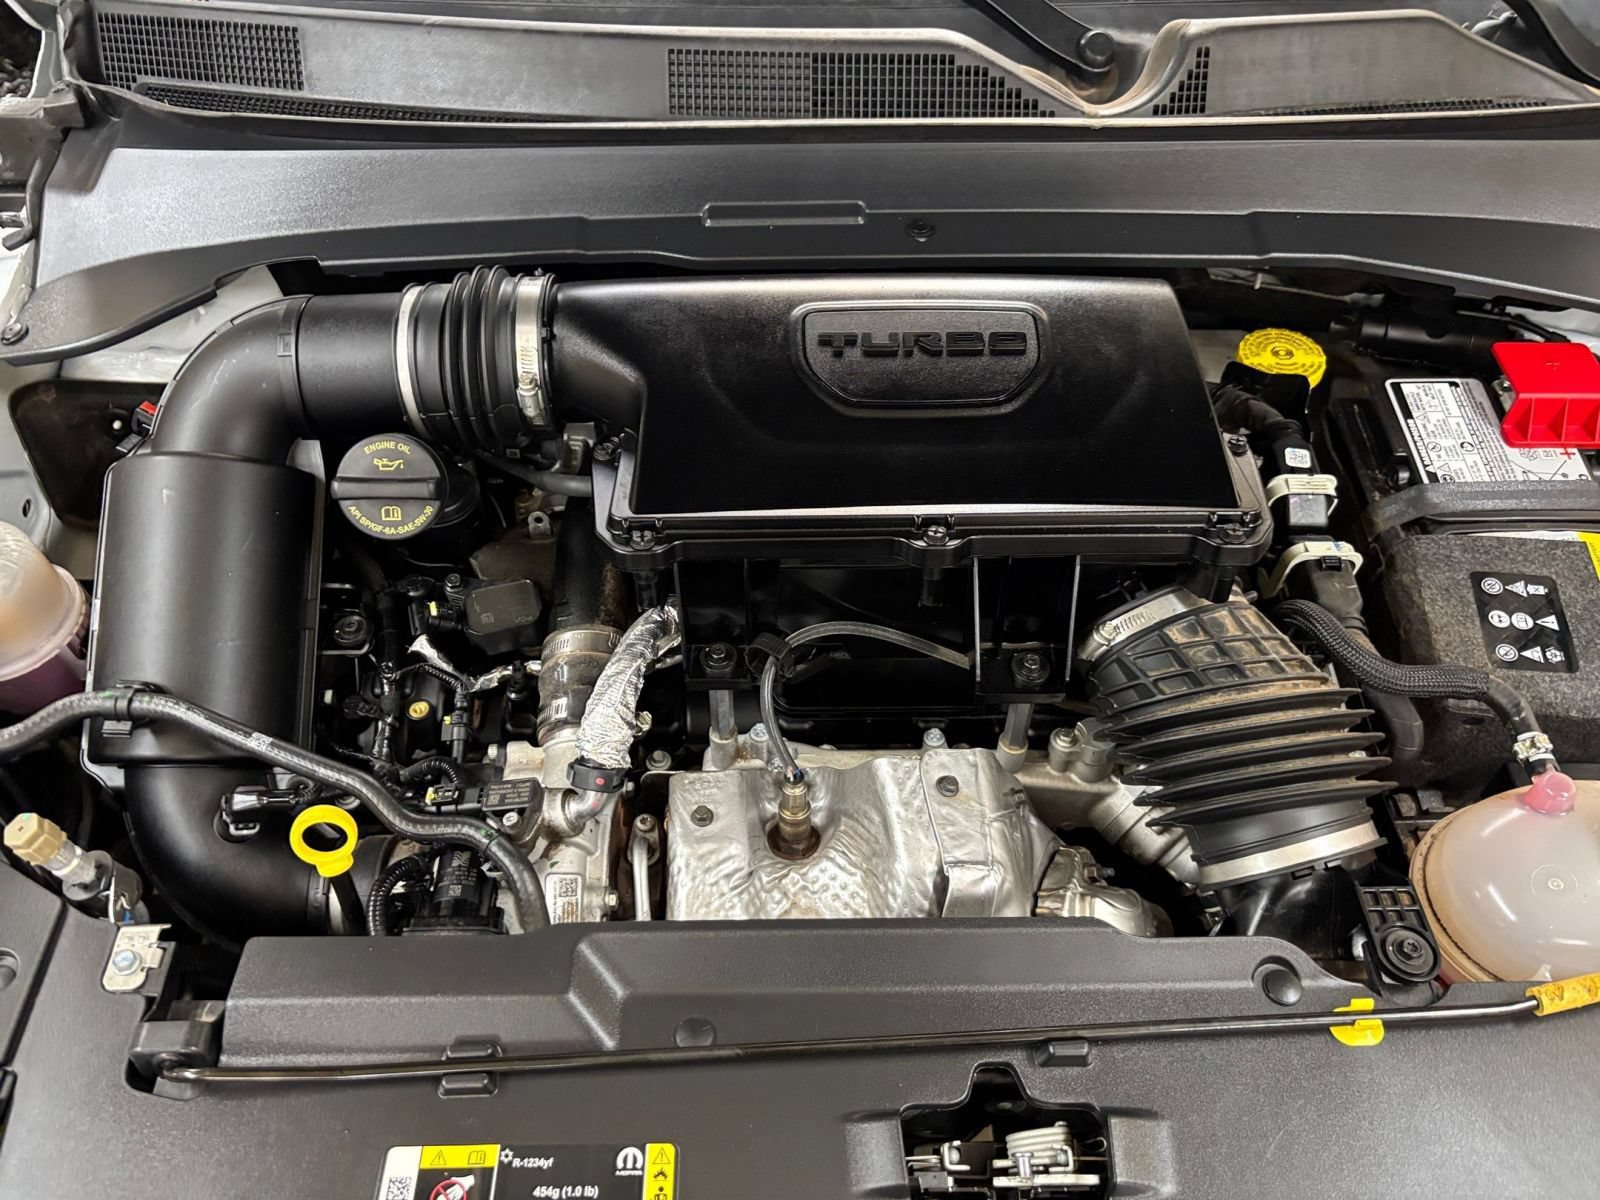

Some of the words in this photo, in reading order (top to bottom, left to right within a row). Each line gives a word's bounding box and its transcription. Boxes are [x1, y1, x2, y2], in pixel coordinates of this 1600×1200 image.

[817, 331, 1028, 357] TURBO
[364, 441, 396, 454] ENGINE
[398, 443, 411, 454] OIL
[348, 506, 361, 519] API
[512, 1157, 554, 1170] R-1234yf
[532, 1185, 560, 1200] 454g
[561, 1185, 582, 1199] (1.0
[583, 1185, 599, 1199] lb)
